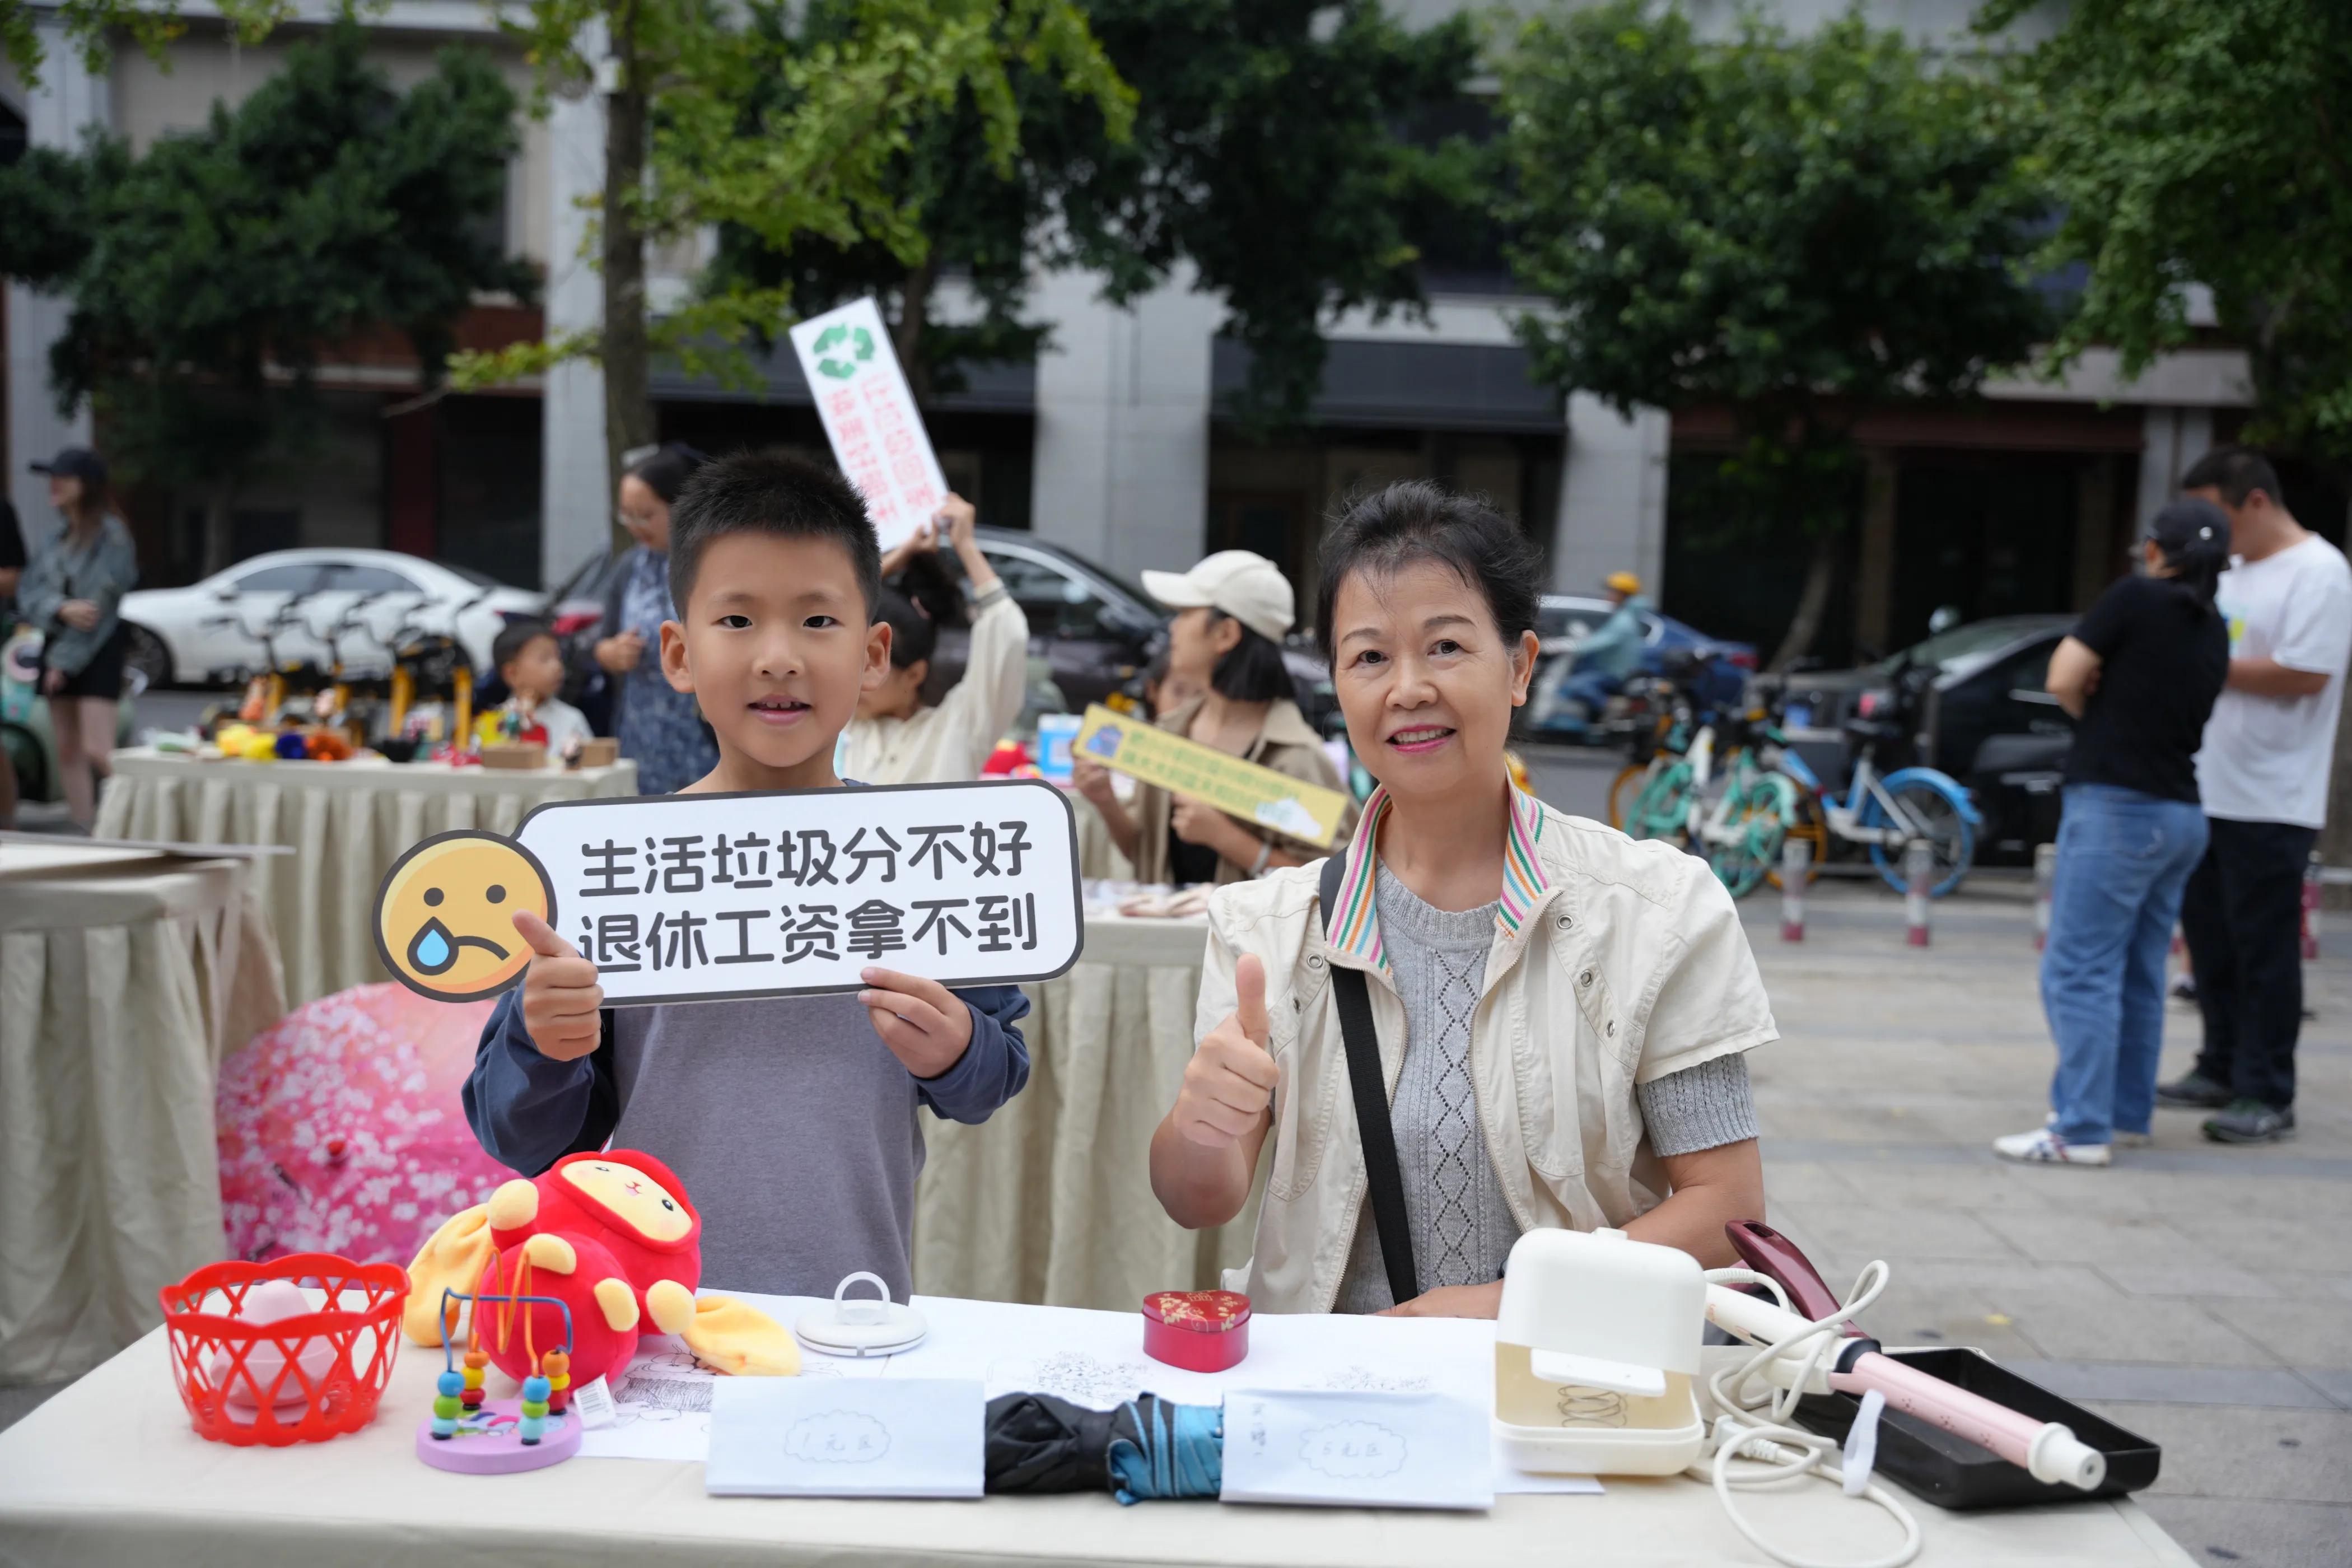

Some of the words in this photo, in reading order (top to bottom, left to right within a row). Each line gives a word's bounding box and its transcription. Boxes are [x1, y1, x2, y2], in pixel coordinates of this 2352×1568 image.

[580, 822, 1032, 897] 生活垃圾分不好
[578, 893, 1037, 973] 退休工资拿不到
